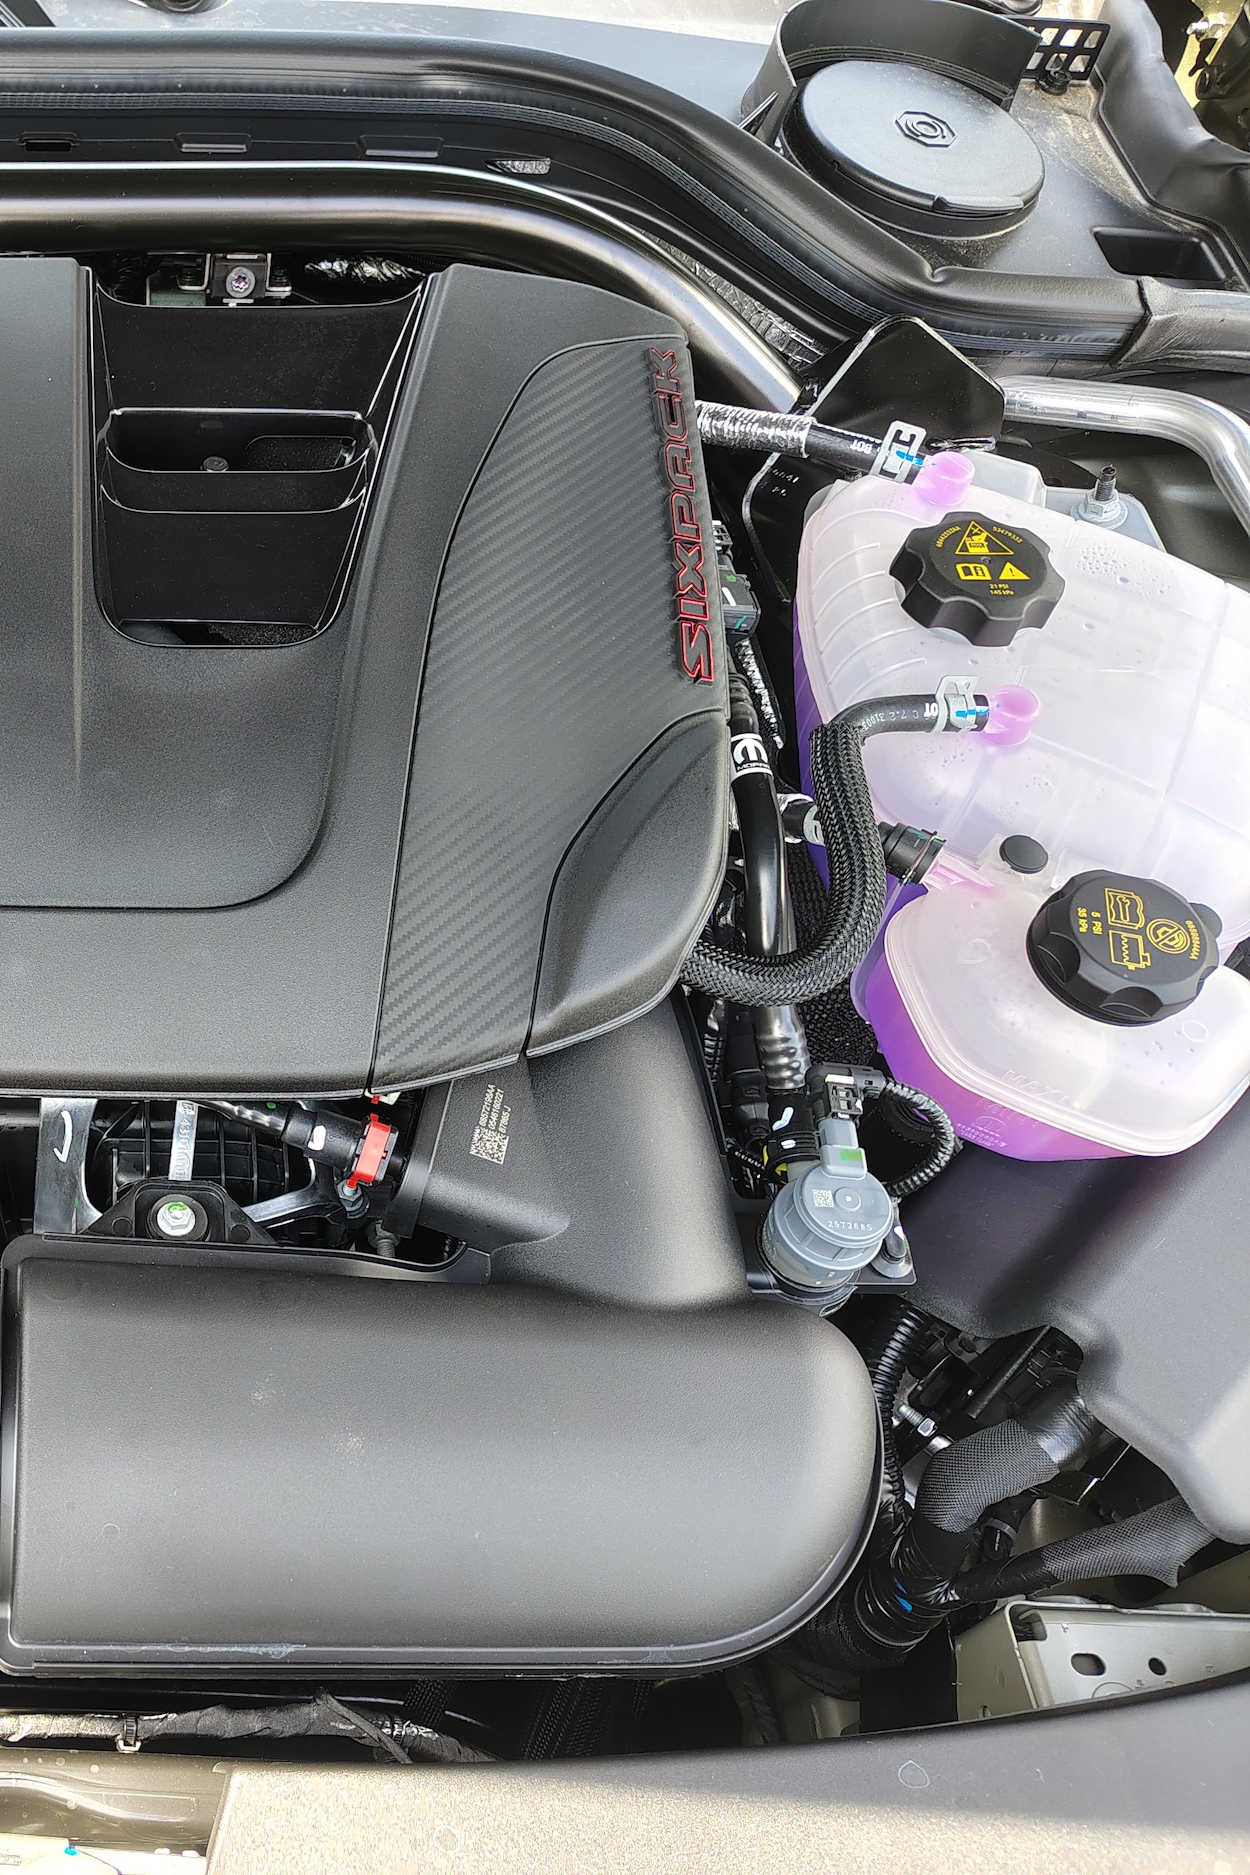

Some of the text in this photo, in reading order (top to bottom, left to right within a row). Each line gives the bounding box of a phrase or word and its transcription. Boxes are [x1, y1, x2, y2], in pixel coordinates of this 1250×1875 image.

[850, 439, 874, 455] BOT
[648, 346, 714, 684] SIXPACK
[889, 709, 908, 721] 7.2
[1077, 907, 1089, 933] 35 kPa
[1091, 920, 1103, 935] PSI
